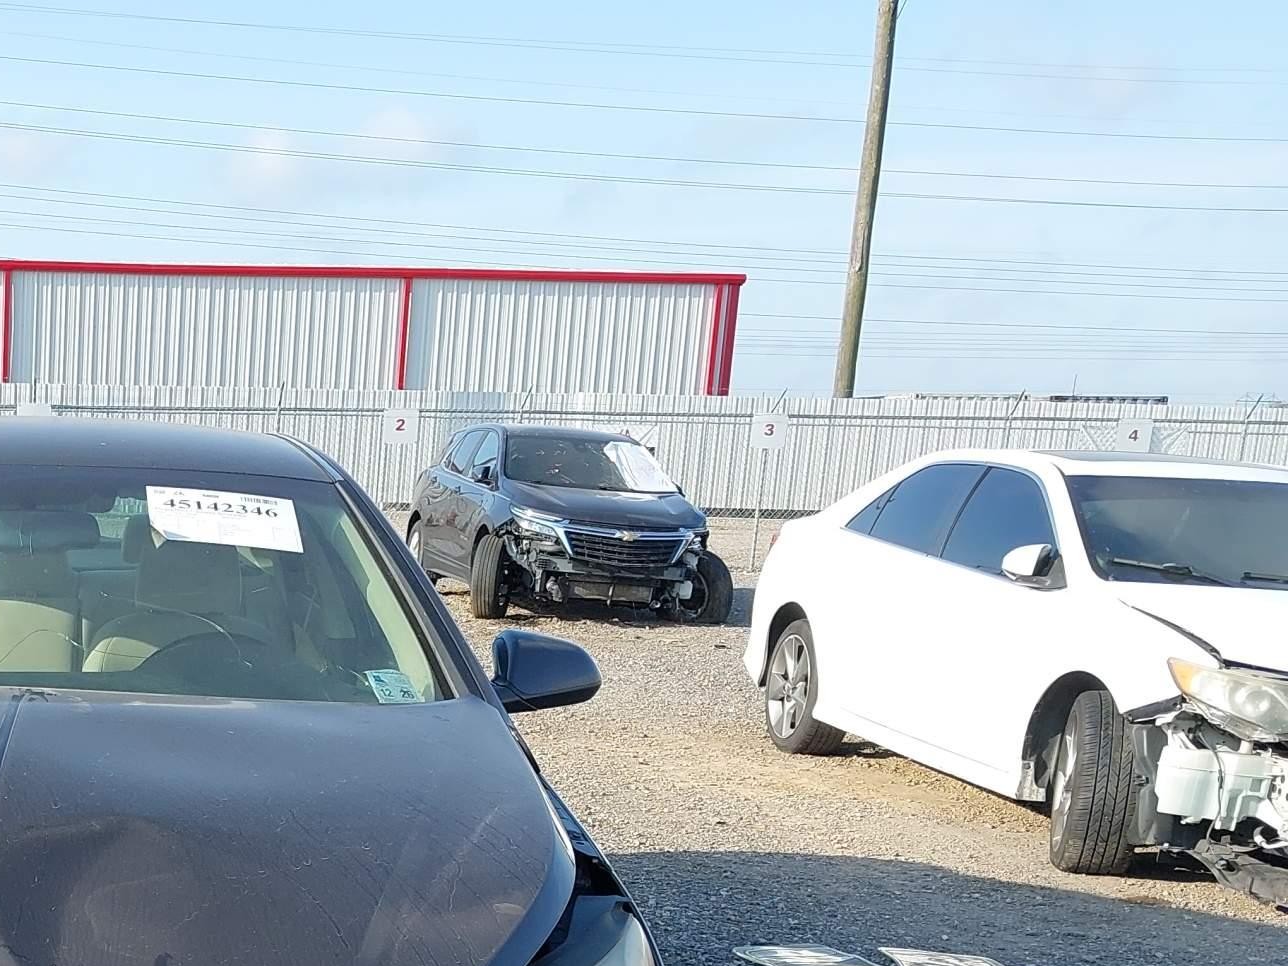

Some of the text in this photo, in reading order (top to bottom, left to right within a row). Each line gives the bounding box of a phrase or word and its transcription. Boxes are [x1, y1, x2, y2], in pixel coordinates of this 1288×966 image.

[395, 418, 406, 431] 2
[763, 423, 775, 436] 3
[1128, 429, 1140, 441] 4
[163, 498, 278, 518] 45142346
[381, 688, 394, 697] 12
